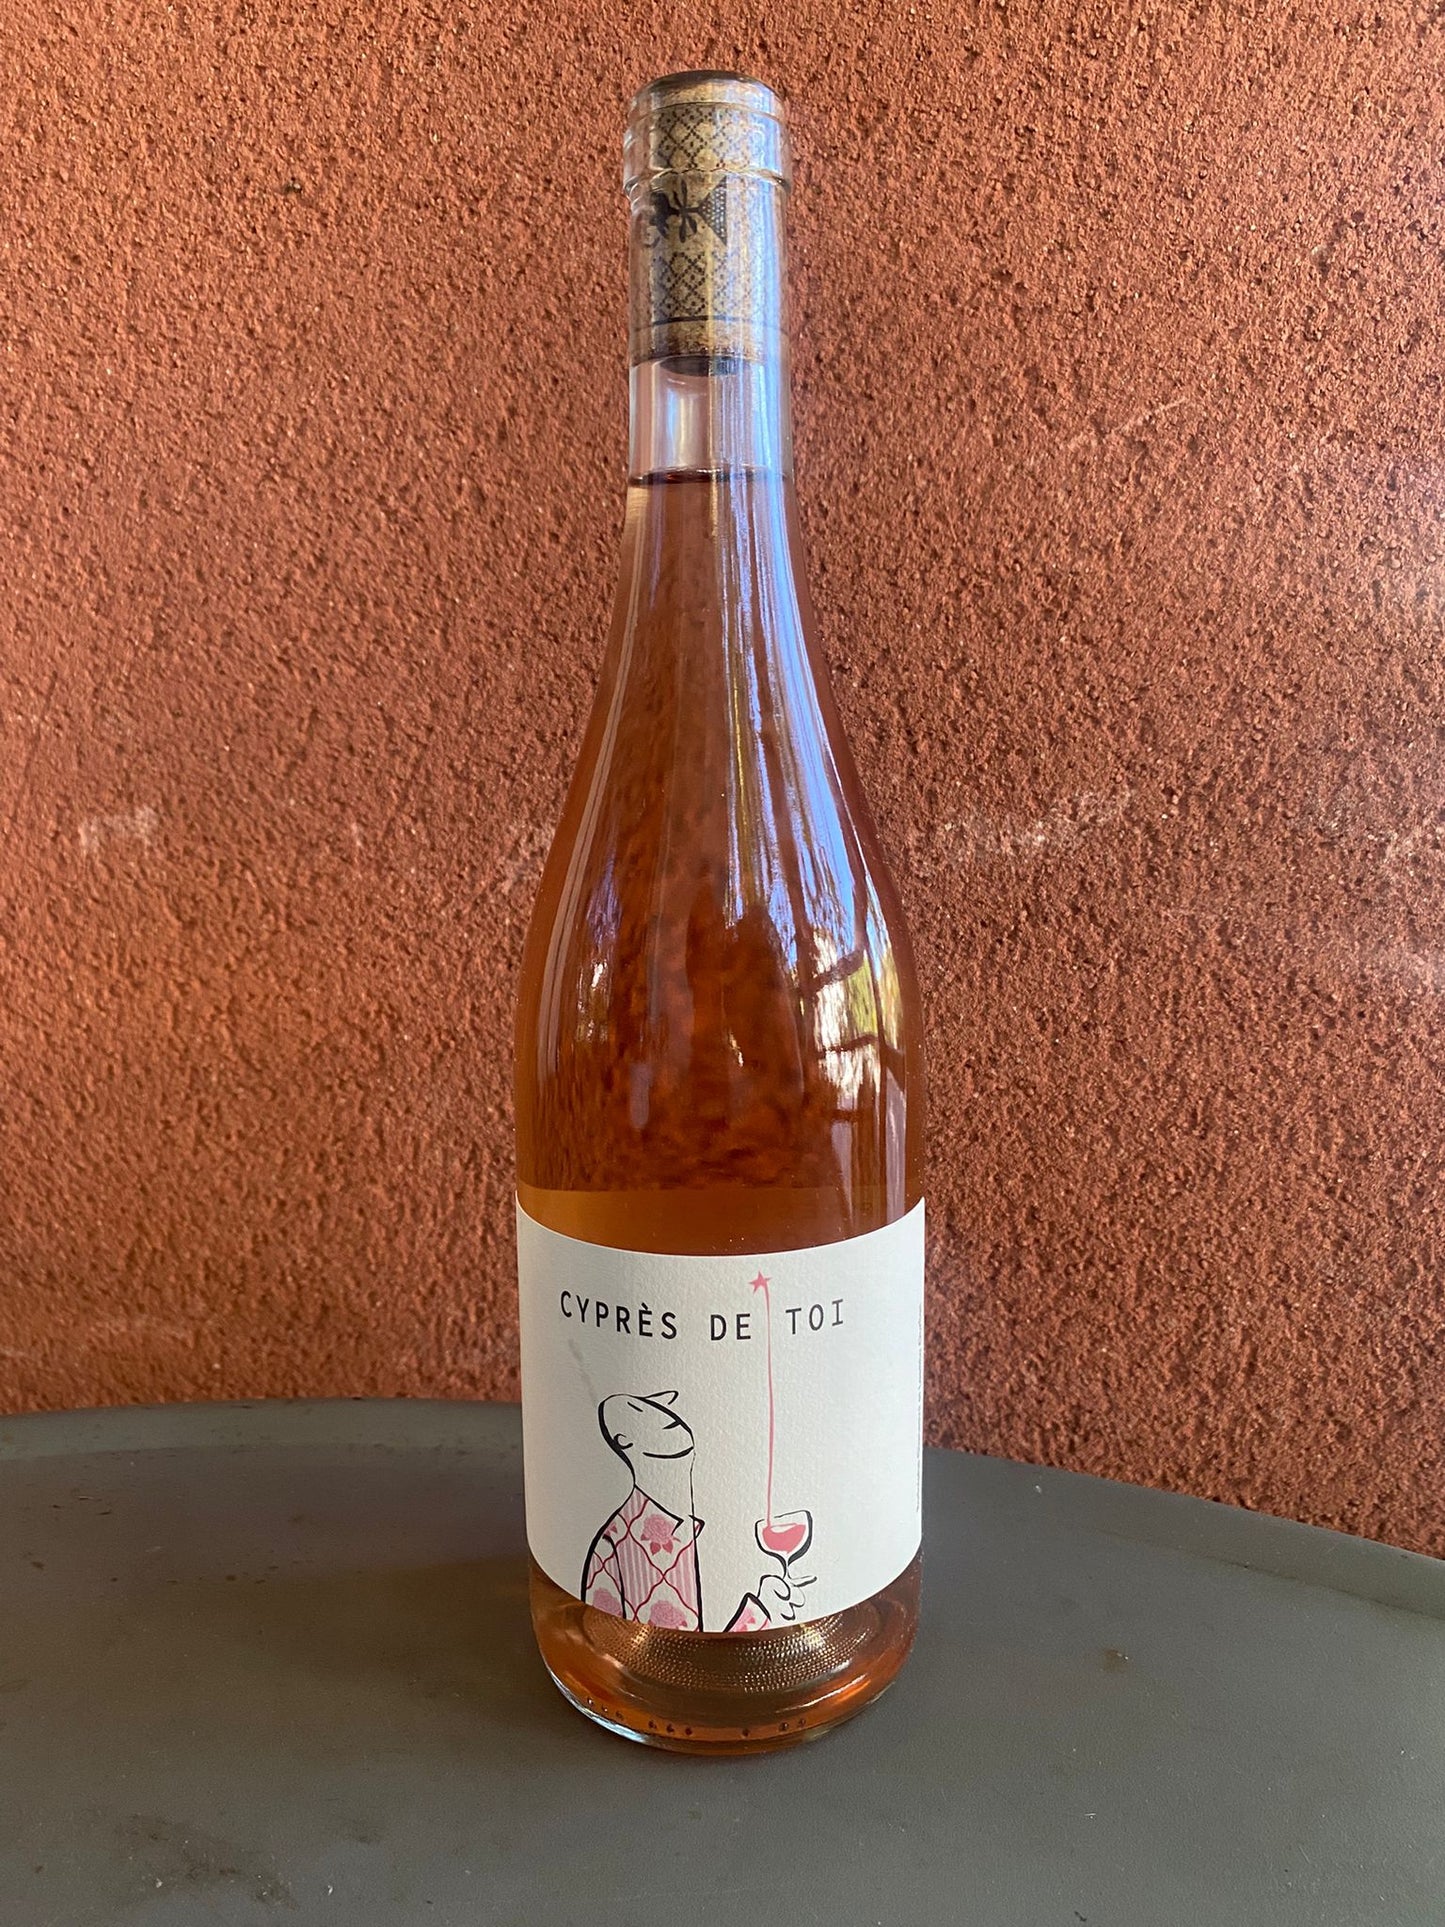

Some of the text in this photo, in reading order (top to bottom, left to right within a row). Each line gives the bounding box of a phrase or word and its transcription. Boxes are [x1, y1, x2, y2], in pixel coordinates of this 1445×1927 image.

[560, 1290, 844, 1341] CYPRÈS DE TOI
